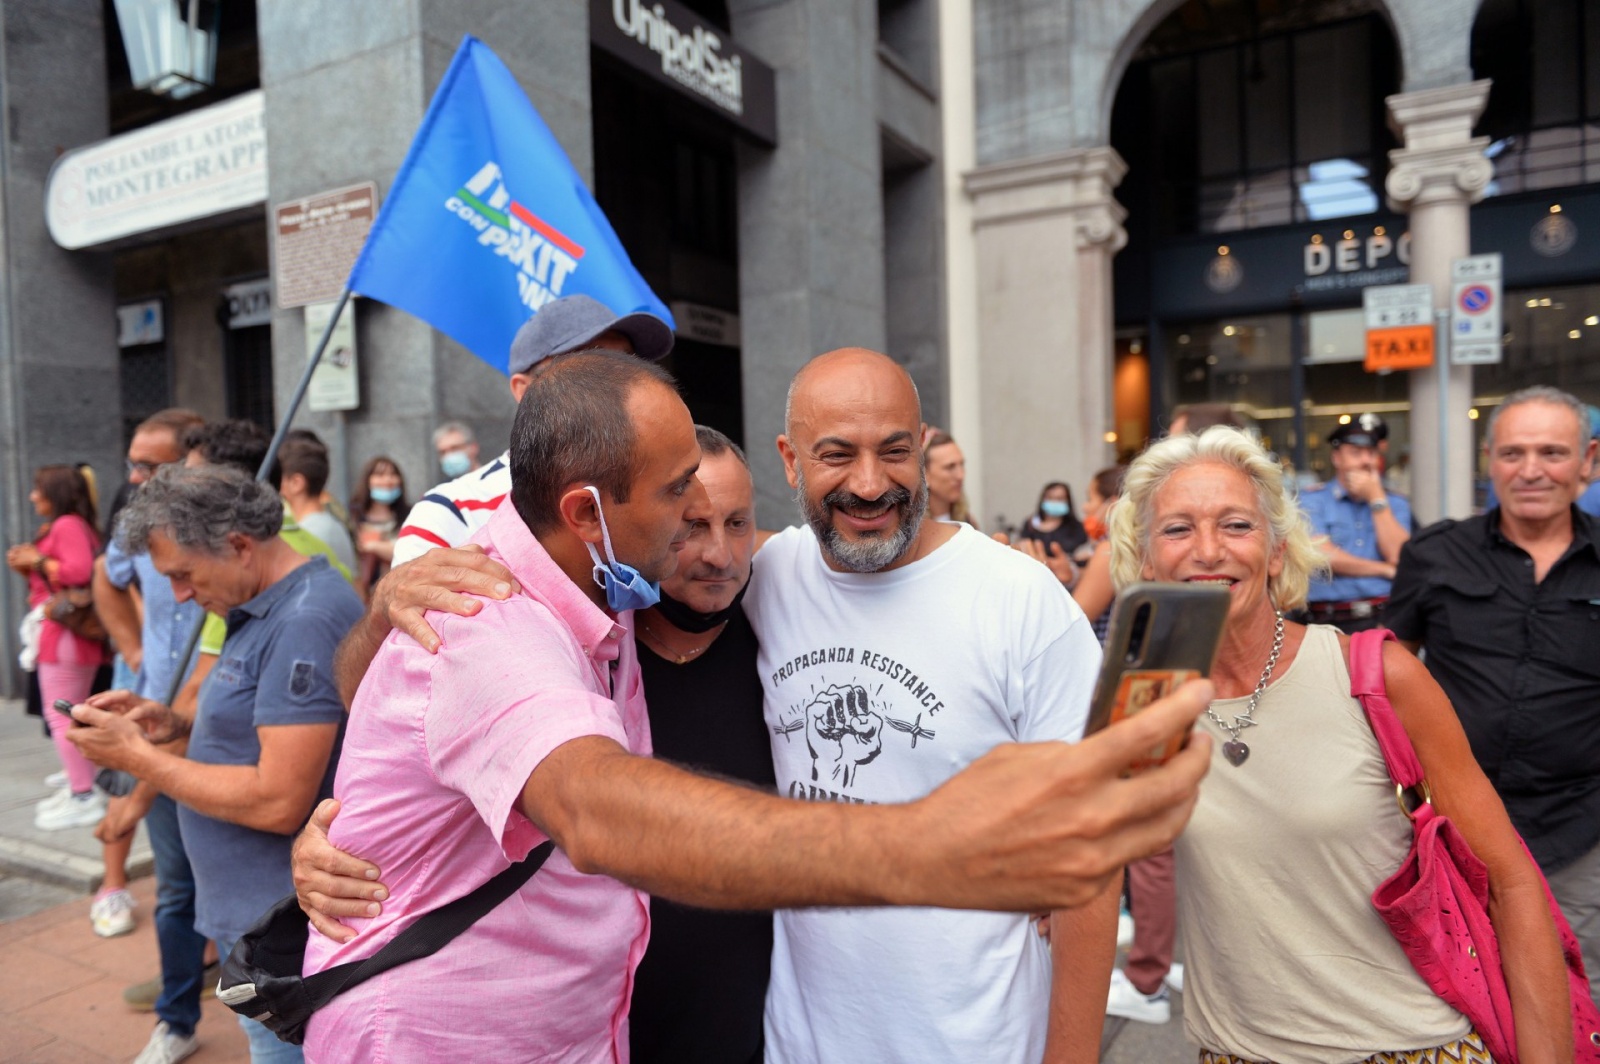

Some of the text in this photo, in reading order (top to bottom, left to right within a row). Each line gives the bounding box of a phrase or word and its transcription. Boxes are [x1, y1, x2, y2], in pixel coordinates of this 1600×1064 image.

[612, 0, 743, 100] UnipolSai
[444, 196, 490, 232] CON
[1371, 336, 1431, 359] TAXI
[772, 647, 945, 717] PROPAGANDA RESISTANCE
